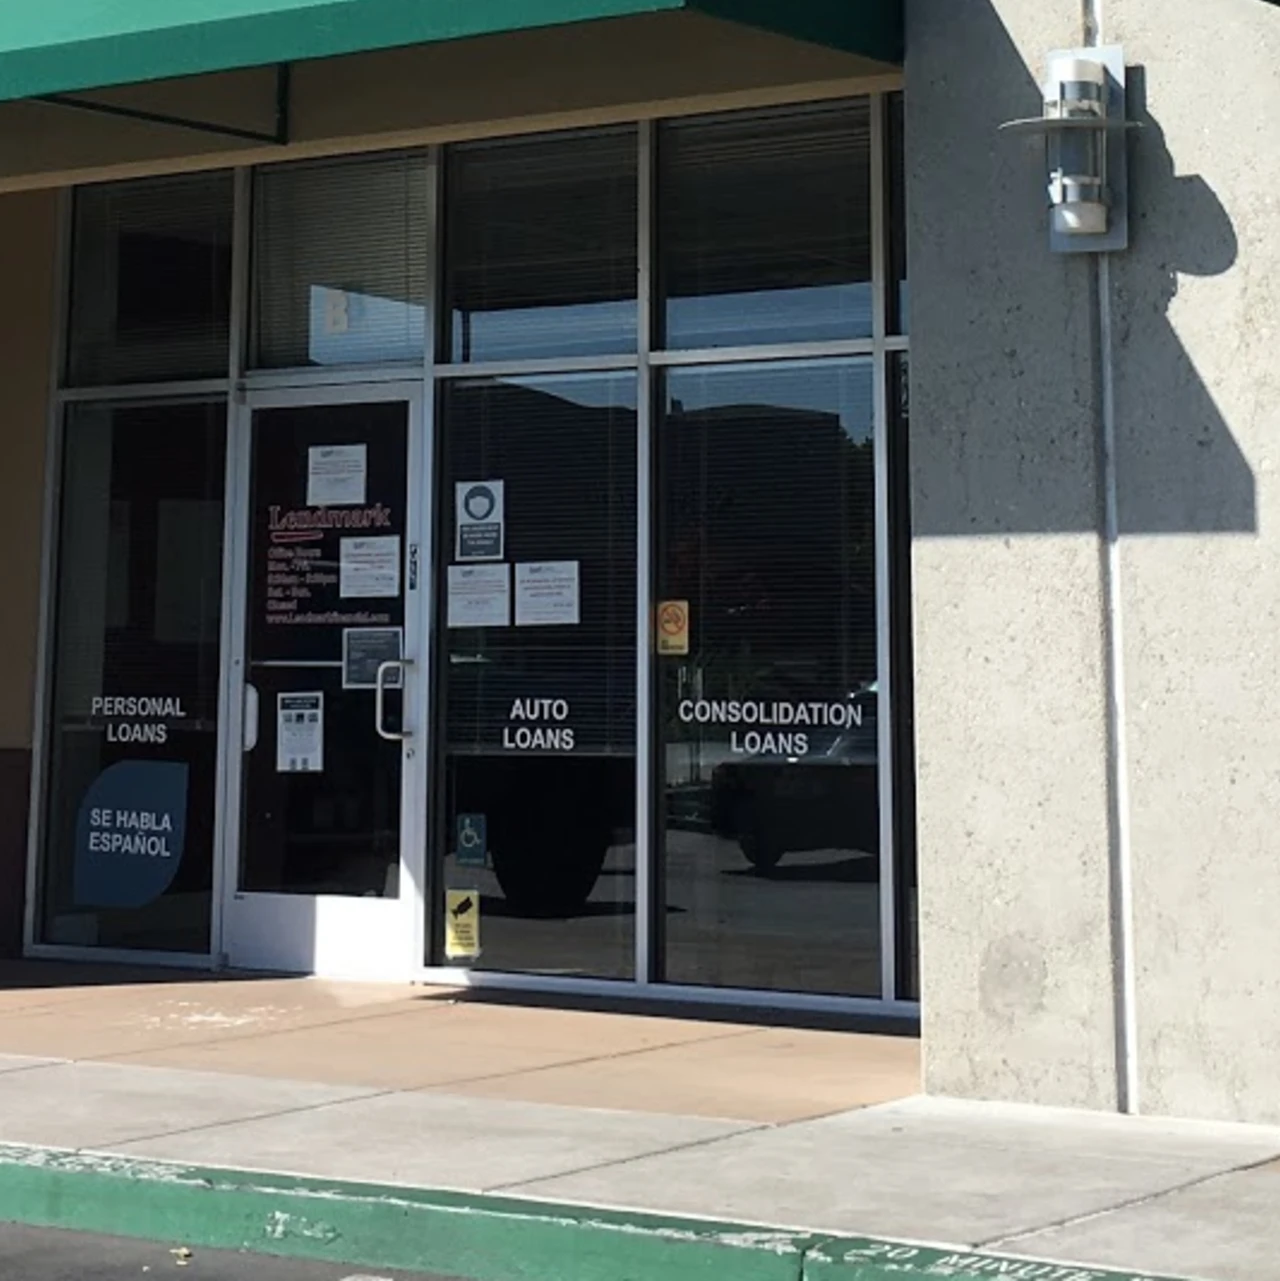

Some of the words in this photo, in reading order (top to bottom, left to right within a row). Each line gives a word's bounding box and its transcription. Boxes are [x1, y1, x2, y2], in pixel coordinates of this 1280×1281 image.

[268, 502, 391, 530] Lendmark
[91, 696, 187, 718] PERSONAL
[510, 699, 569, 720] AUTO
[678, 699, 863, 729] CONSOLIDATION
[107, 722, 168, 743] LOANS
[503, 727, 574, 750] LOANS
[731, 731, 809, 756] LOANS
[89, 807, 112, 826] SE
[116, 810, 173, 832] HABLA
[88, 828, 171, 857] ESPAÑOL
